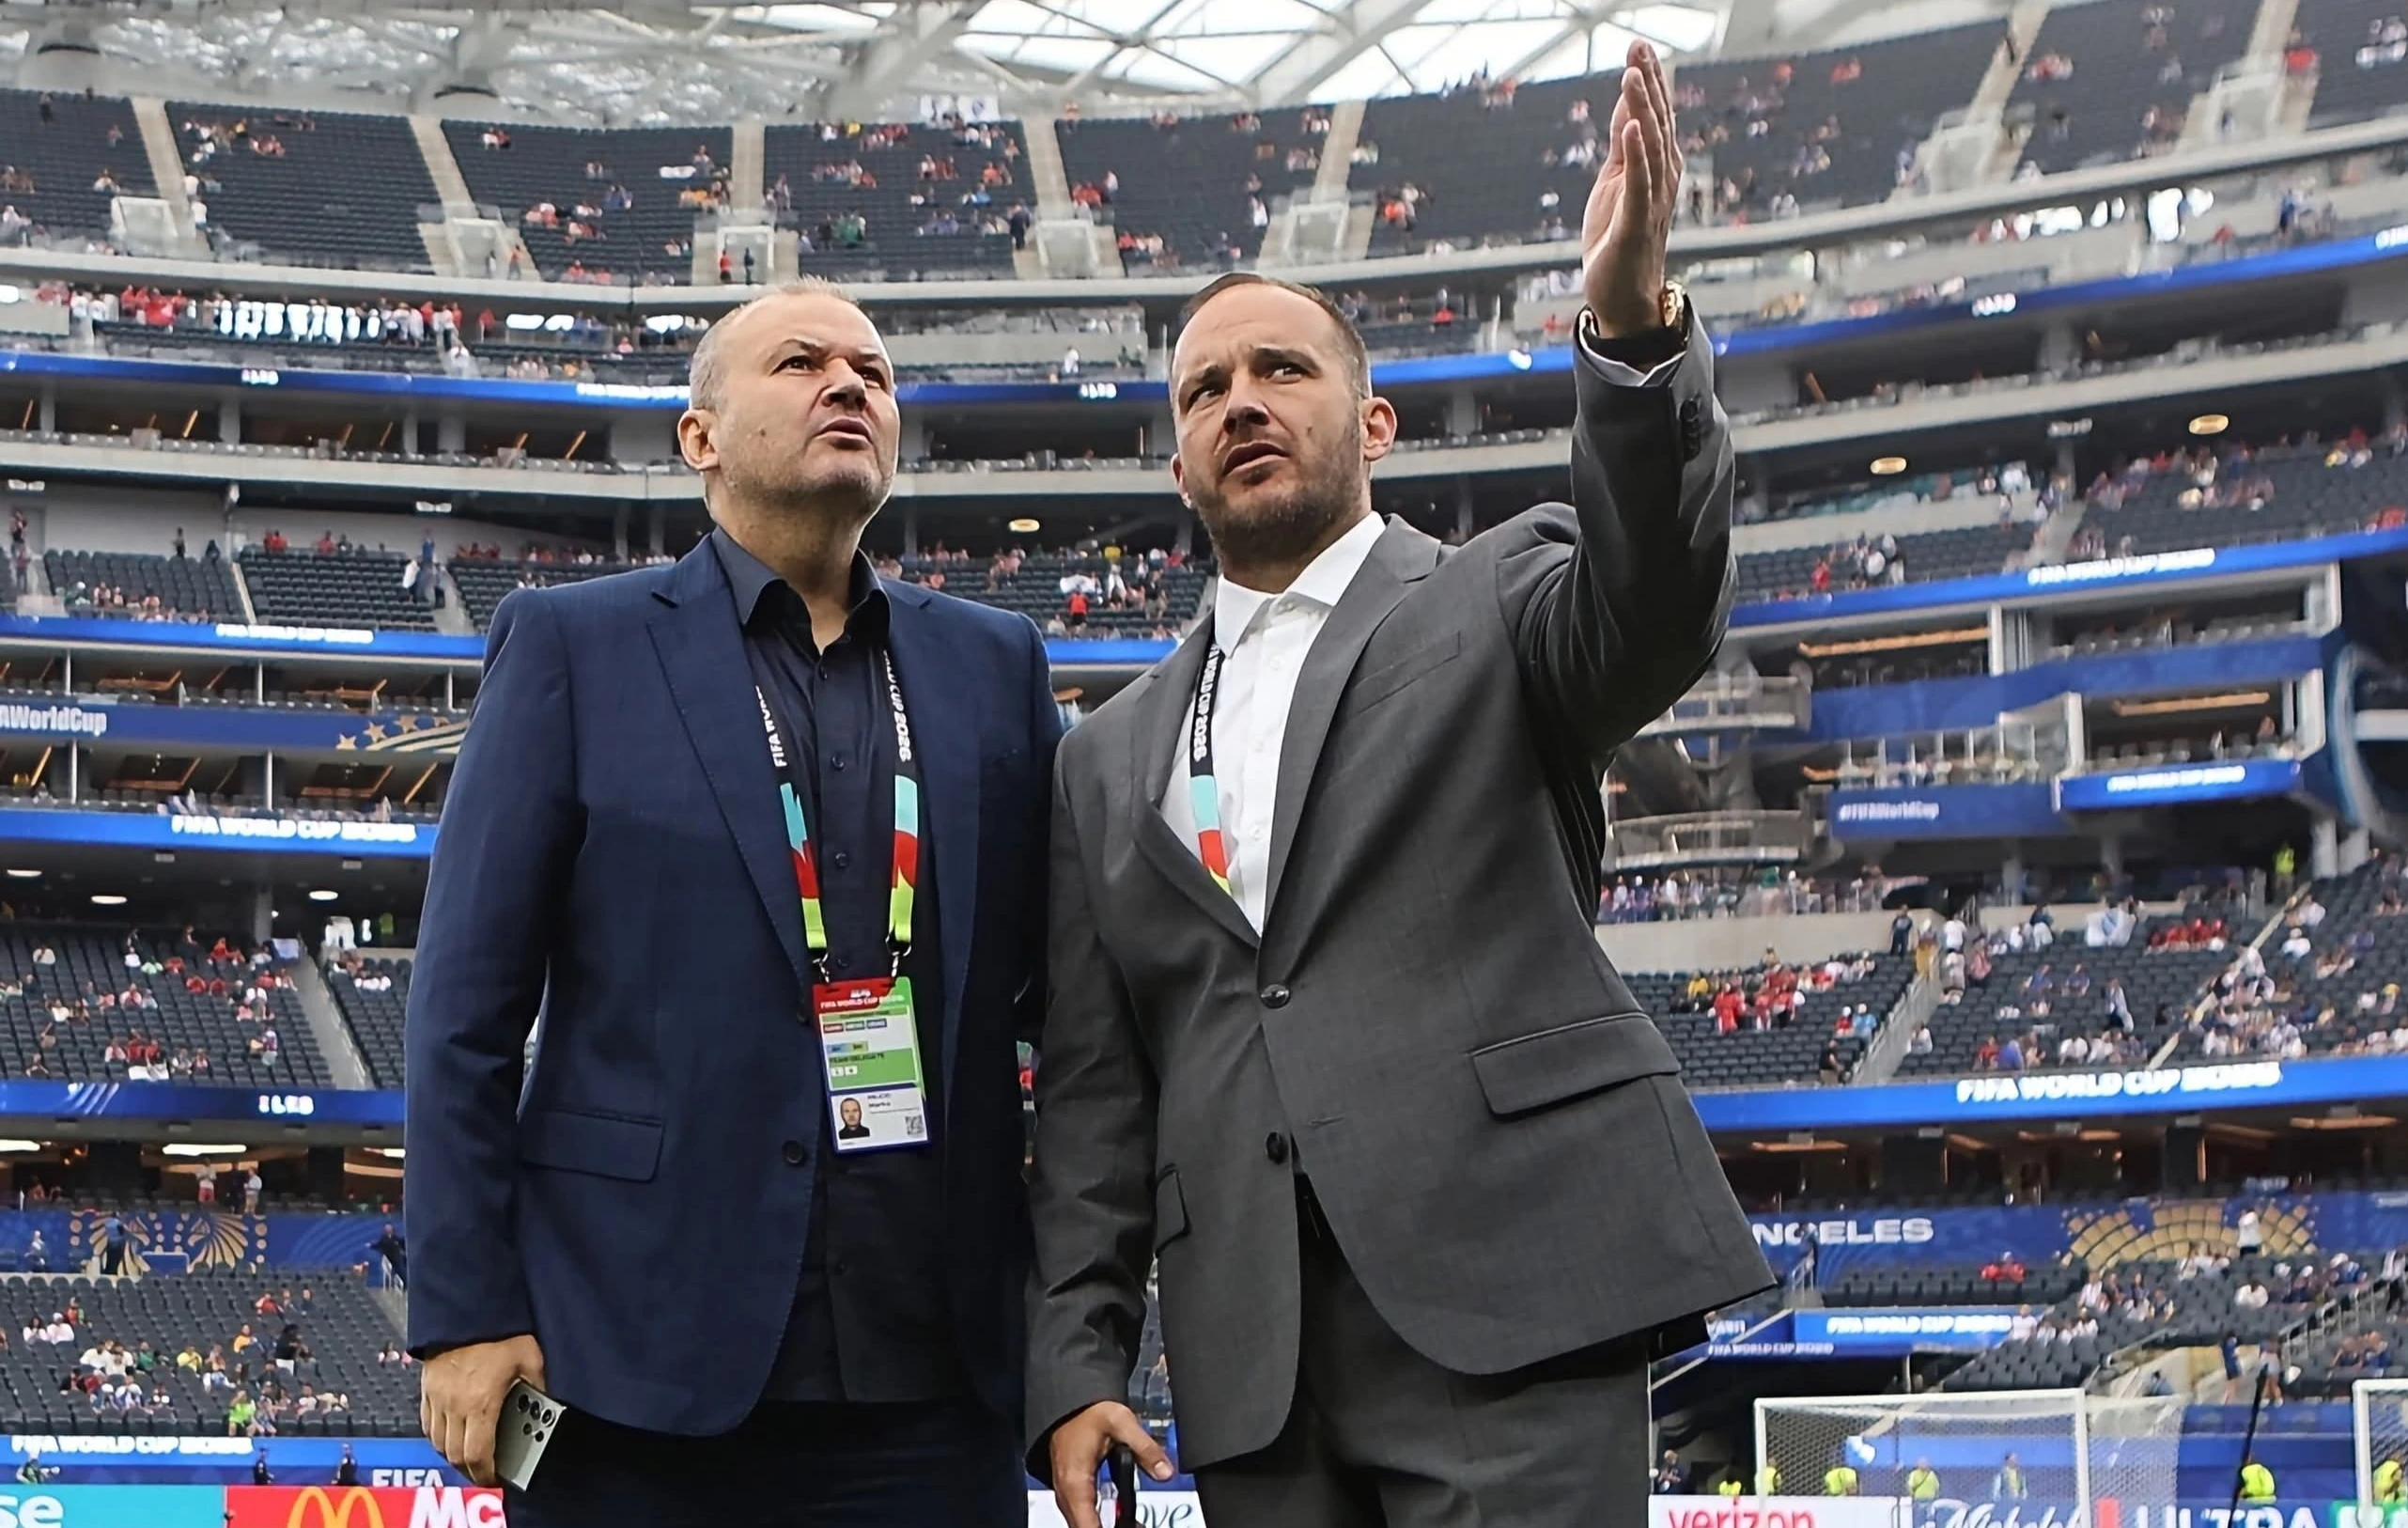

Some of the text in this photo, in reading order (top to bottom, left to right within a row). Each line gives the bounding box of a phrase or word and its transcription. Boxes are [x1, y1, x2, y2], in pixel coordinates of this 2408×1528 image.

[769, 733, 787, 767] FIFA
[219, 818, 297, 838] WORLD
[1957, 1077, 2019, 1103] FIFA
[2020, 1072, 2123, 1100] WORLD
[2123, 1068, 2181, 1096] CUP
[1732, 1343, 1773, 1356] WORLD
[59, 1436, 136, 1453] WORLD
[136, 1436, 179, 1454] CUP
[373, 1469, 443, 1487] FIFA
